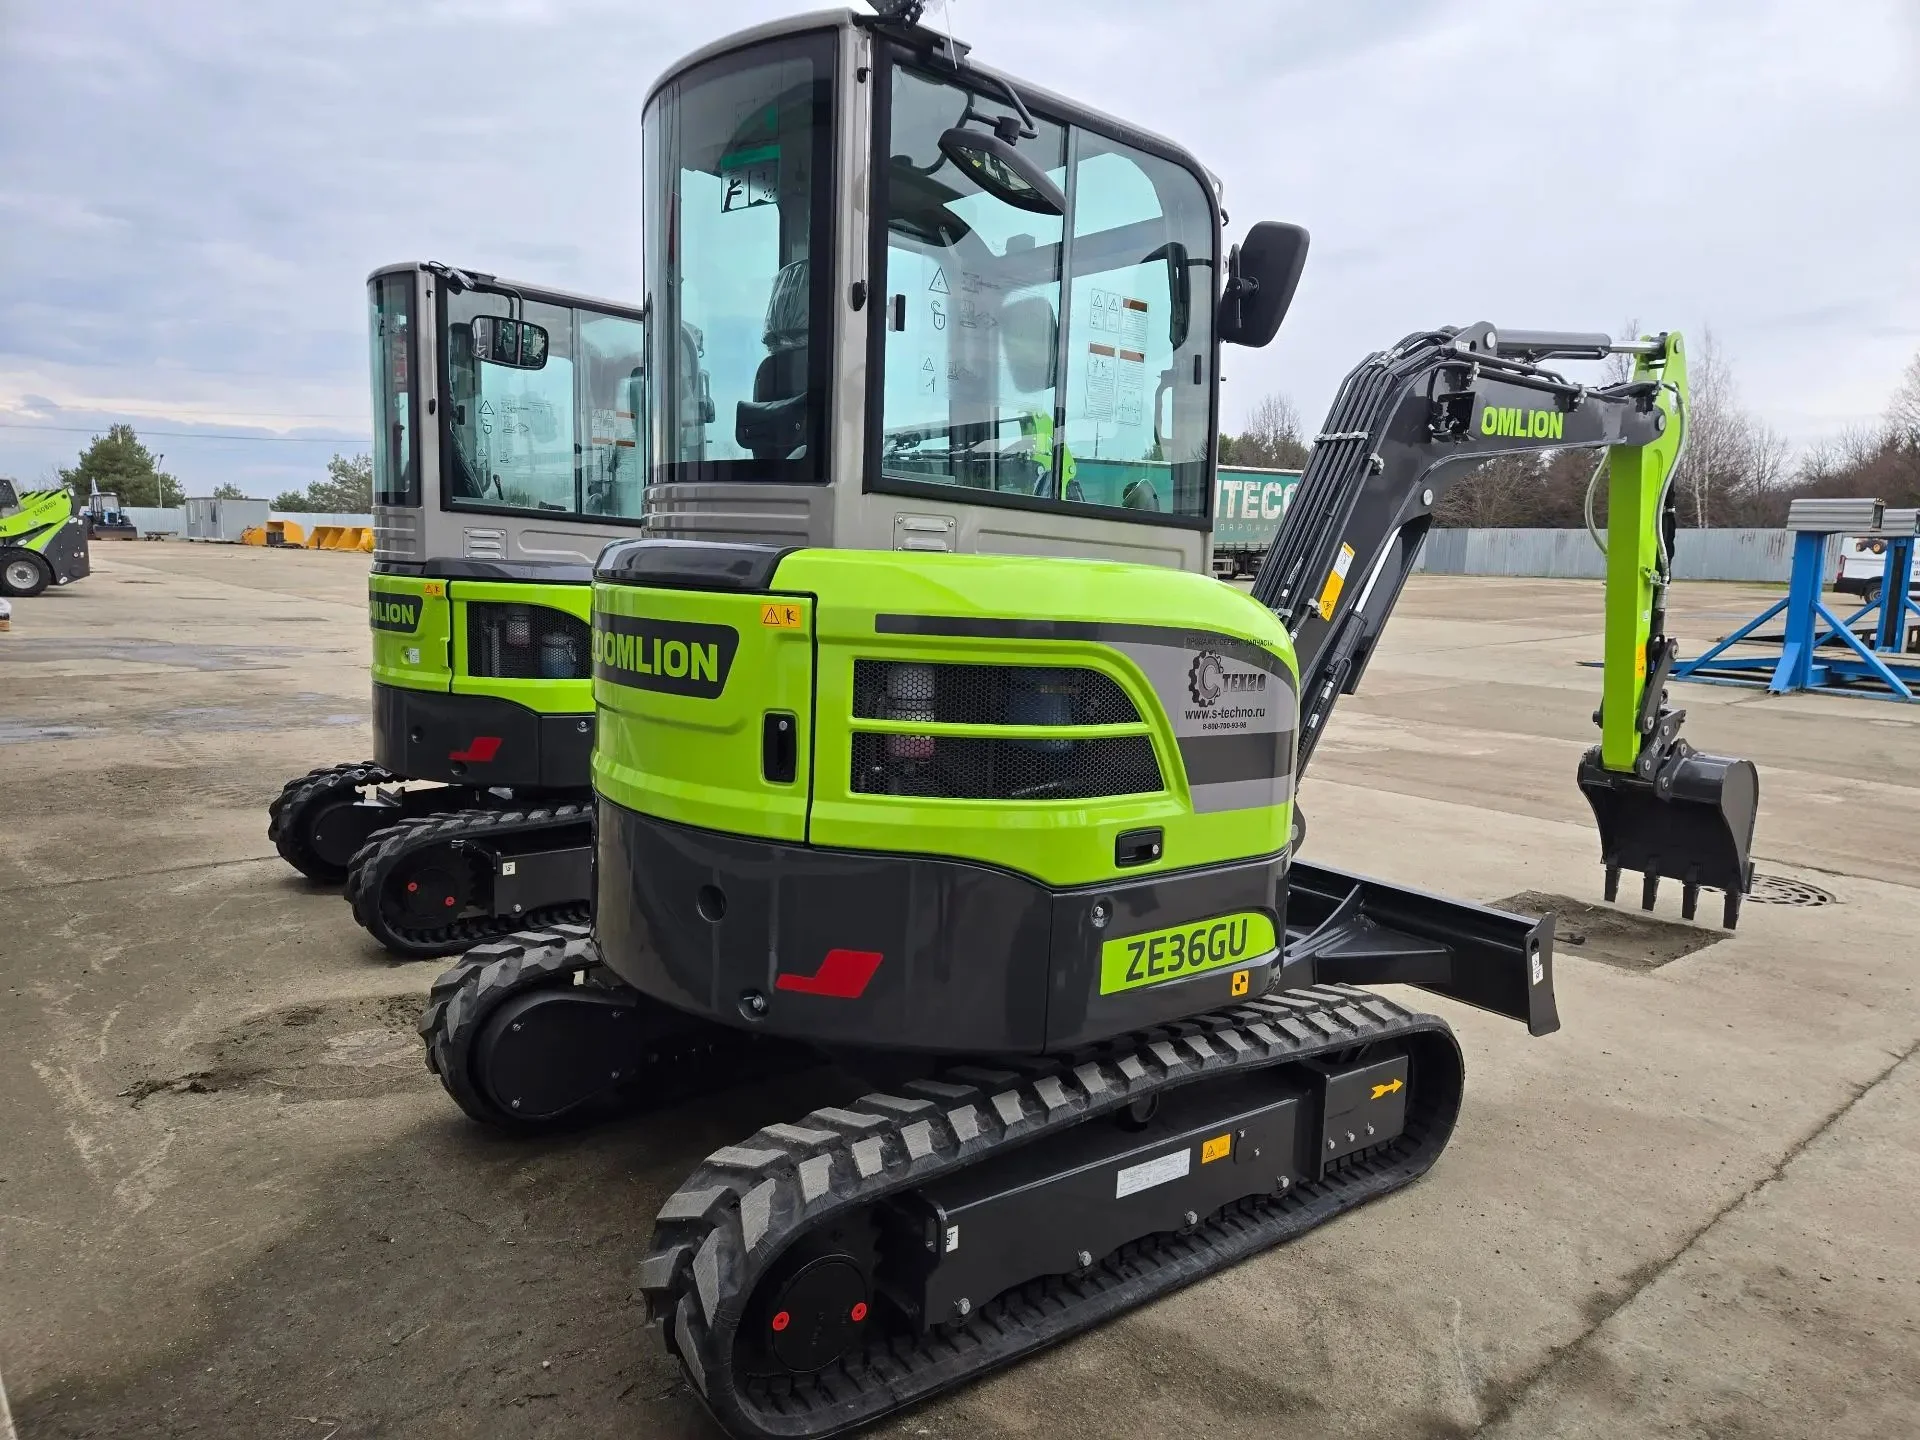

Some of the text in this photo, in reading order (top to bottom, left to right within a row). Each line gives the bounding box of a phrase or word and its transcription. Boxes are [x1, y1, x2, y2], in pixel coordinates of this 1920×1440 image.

[1481, 406, 1564, 440] OMLION
[370, 600, 415, 625] MLION
[1185, 706, 1266, 720] www.s-techno.ru
[1125, 918, 1248, 983] ZE36GU
